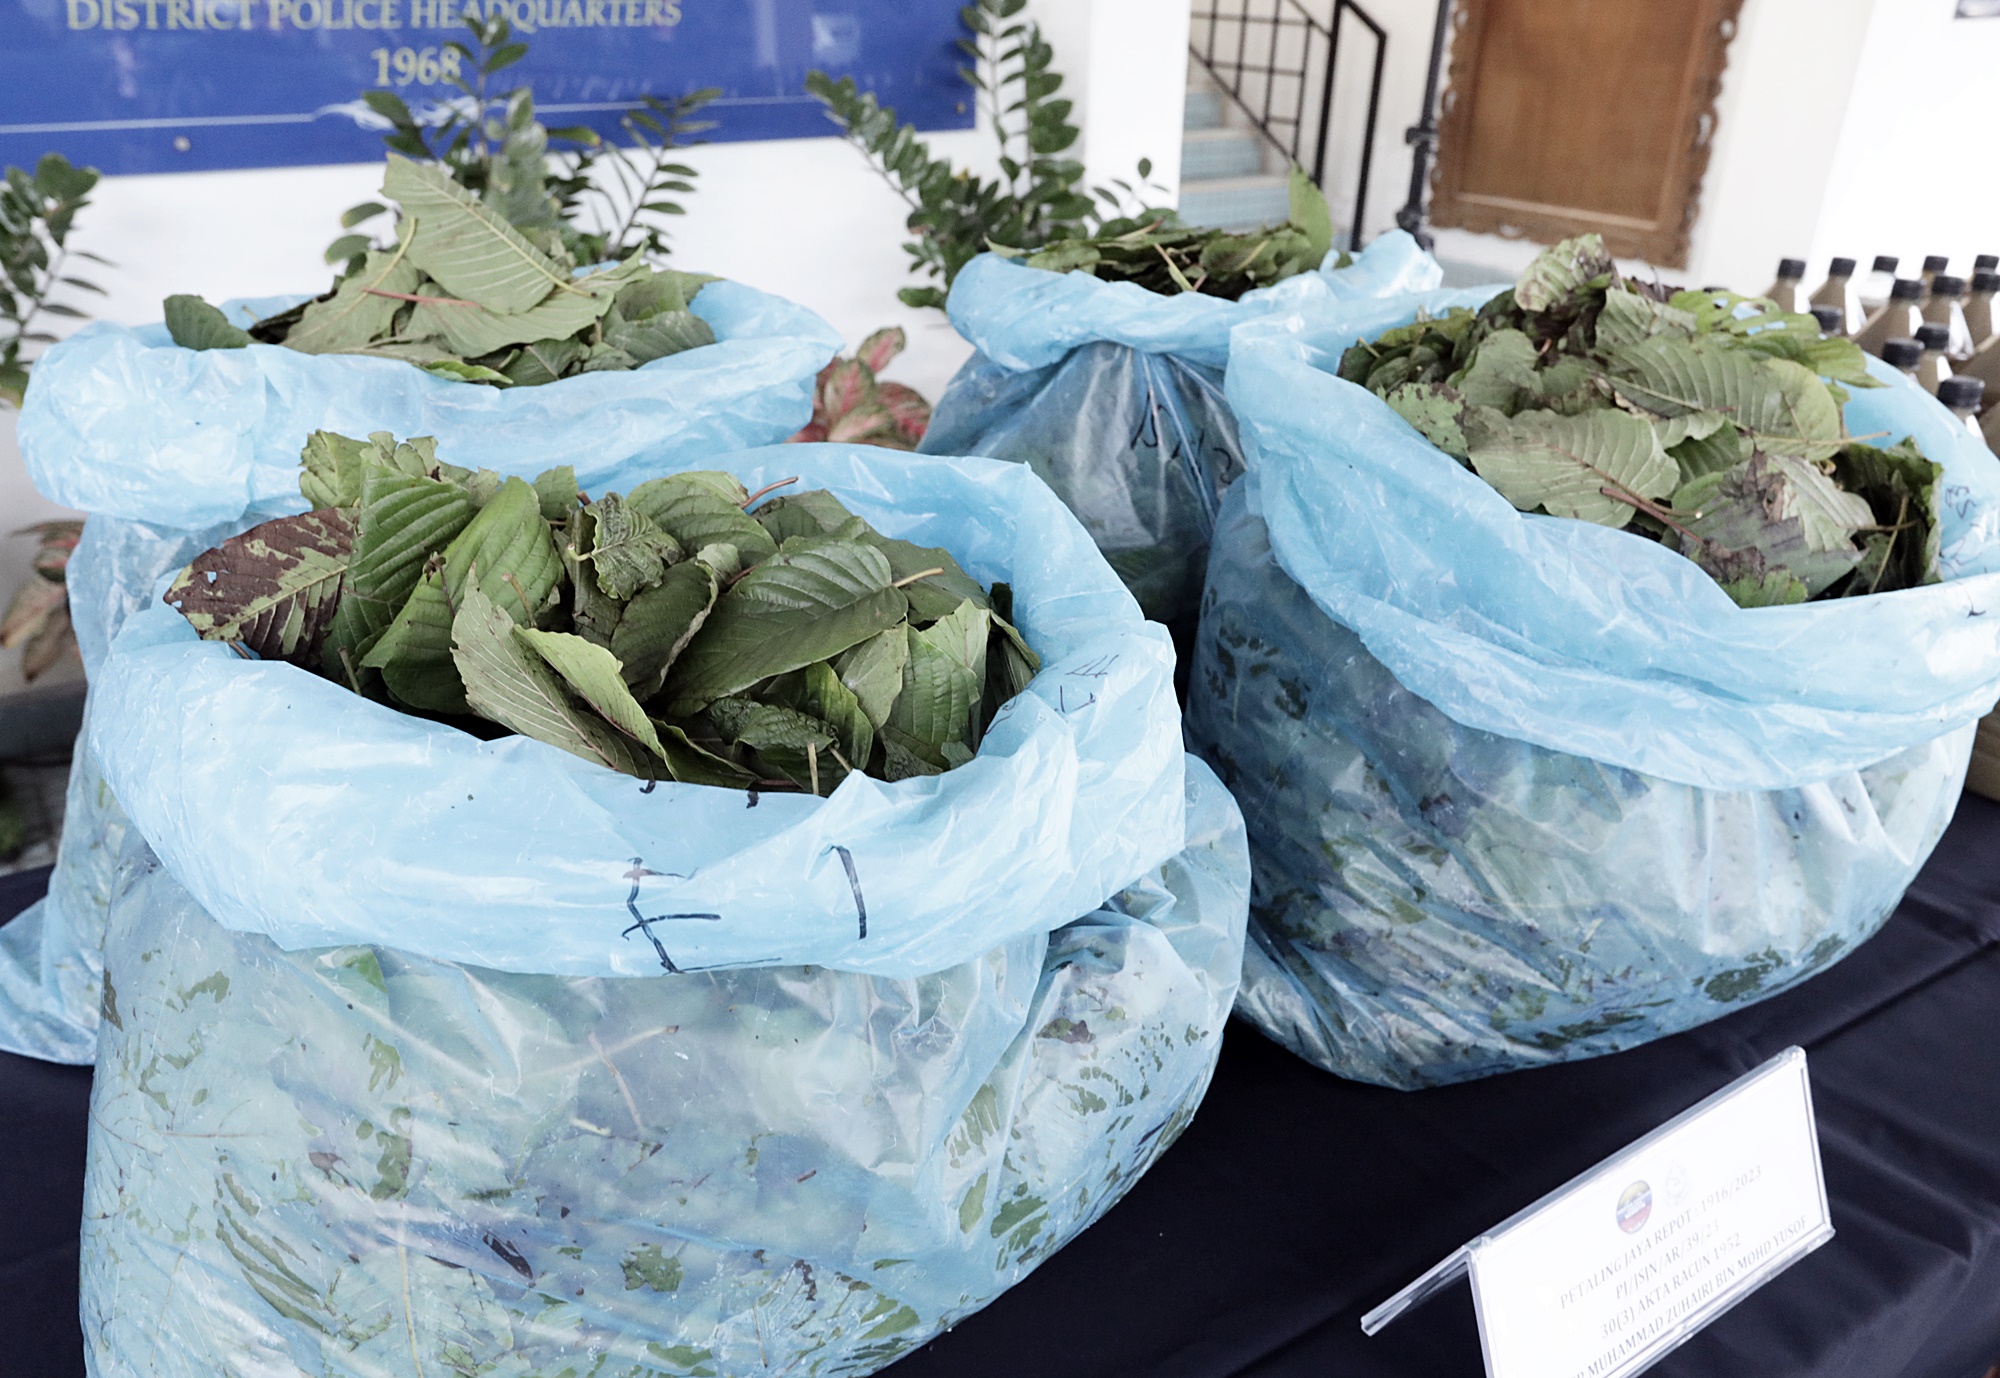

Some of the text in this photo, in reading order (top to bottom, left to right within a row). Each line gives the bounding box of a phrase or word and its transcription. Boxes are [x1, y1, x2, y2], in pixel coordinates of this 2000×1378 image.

[67, 0, 682, 34] DISTRICT POLICE HEADQUARTERS
[370, 46, 462, 87] 1968
[1560, 1256, 1622, 1310] PETALING
[1624, 1237, 1652, 1270] JAYA
[1655, 1208, 1693, 1245] REPOT
[1700, 1164, 1762, 1213] 1916/2023
[1600, 1232, 1743, 1340] 30(3) AKTA RACUN 1952
[1587, 1214, 1809, 1378] MUHAMMAD ZUHAIRI BIN MOHD YUSOF
